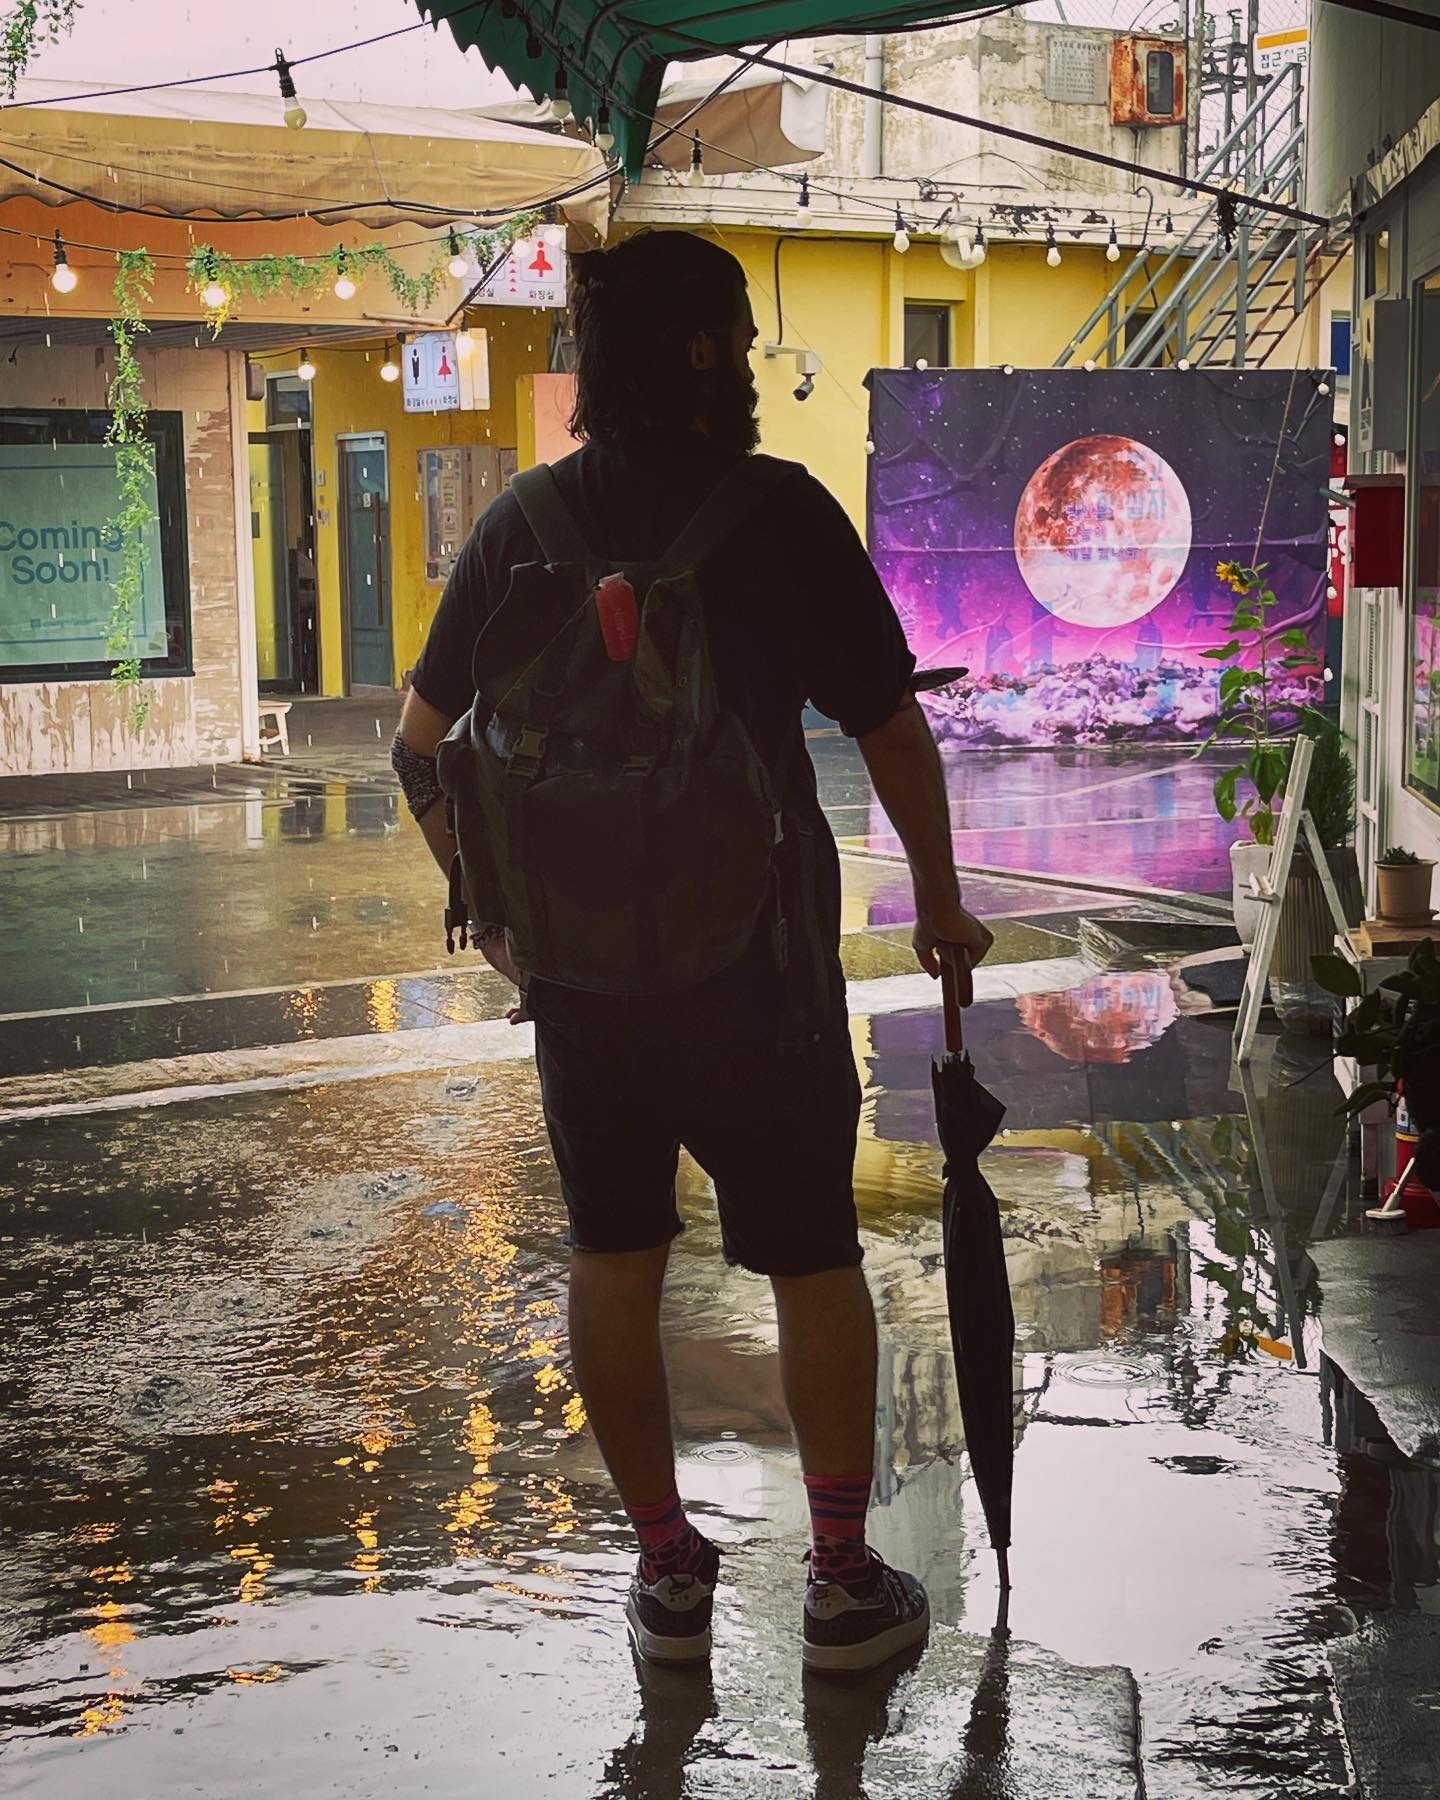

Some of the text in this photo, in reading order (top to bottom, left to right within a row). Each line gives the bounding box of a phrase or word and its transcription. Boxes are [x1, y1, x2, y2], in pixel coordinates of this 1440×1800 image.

[529, 290, 554, 300] 화장실
[0, 520, 125, 552] Coming
[11, 555, 109, 585] Soon!
